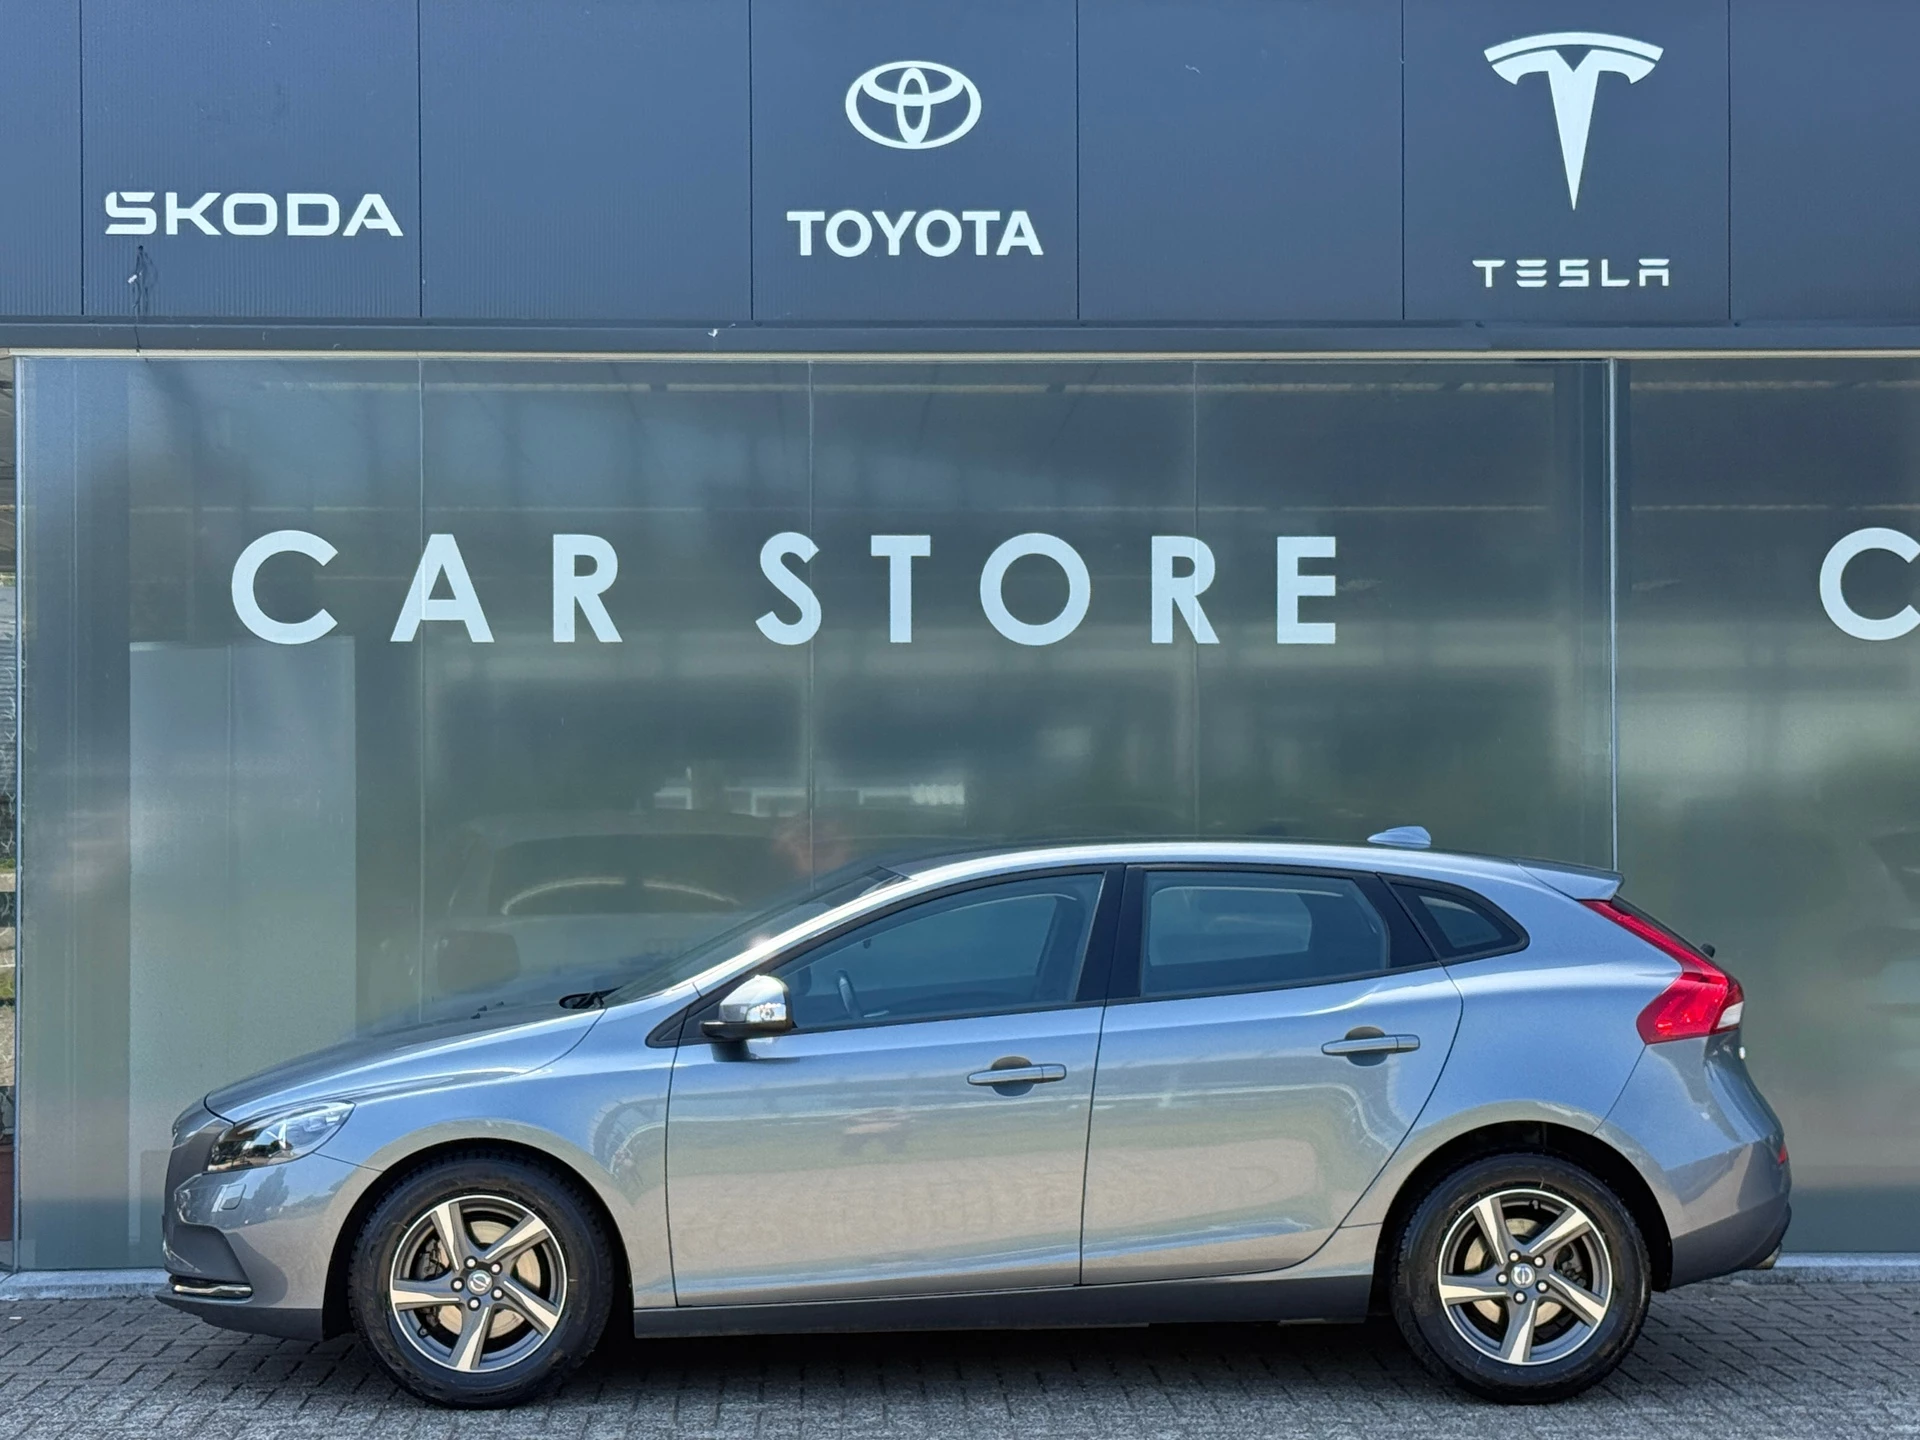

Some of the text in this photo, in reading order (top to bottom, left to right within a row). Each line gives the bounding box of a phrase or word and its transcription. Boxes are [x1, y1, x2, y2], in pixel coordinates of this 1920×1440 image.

[105, 191, 404, 237] SKODA
[787, 209, 1044, 258] TOYOTA
[1473, 258, 1670, 288] TESLA
[231, 529, 1336, 645] CAR STORE
